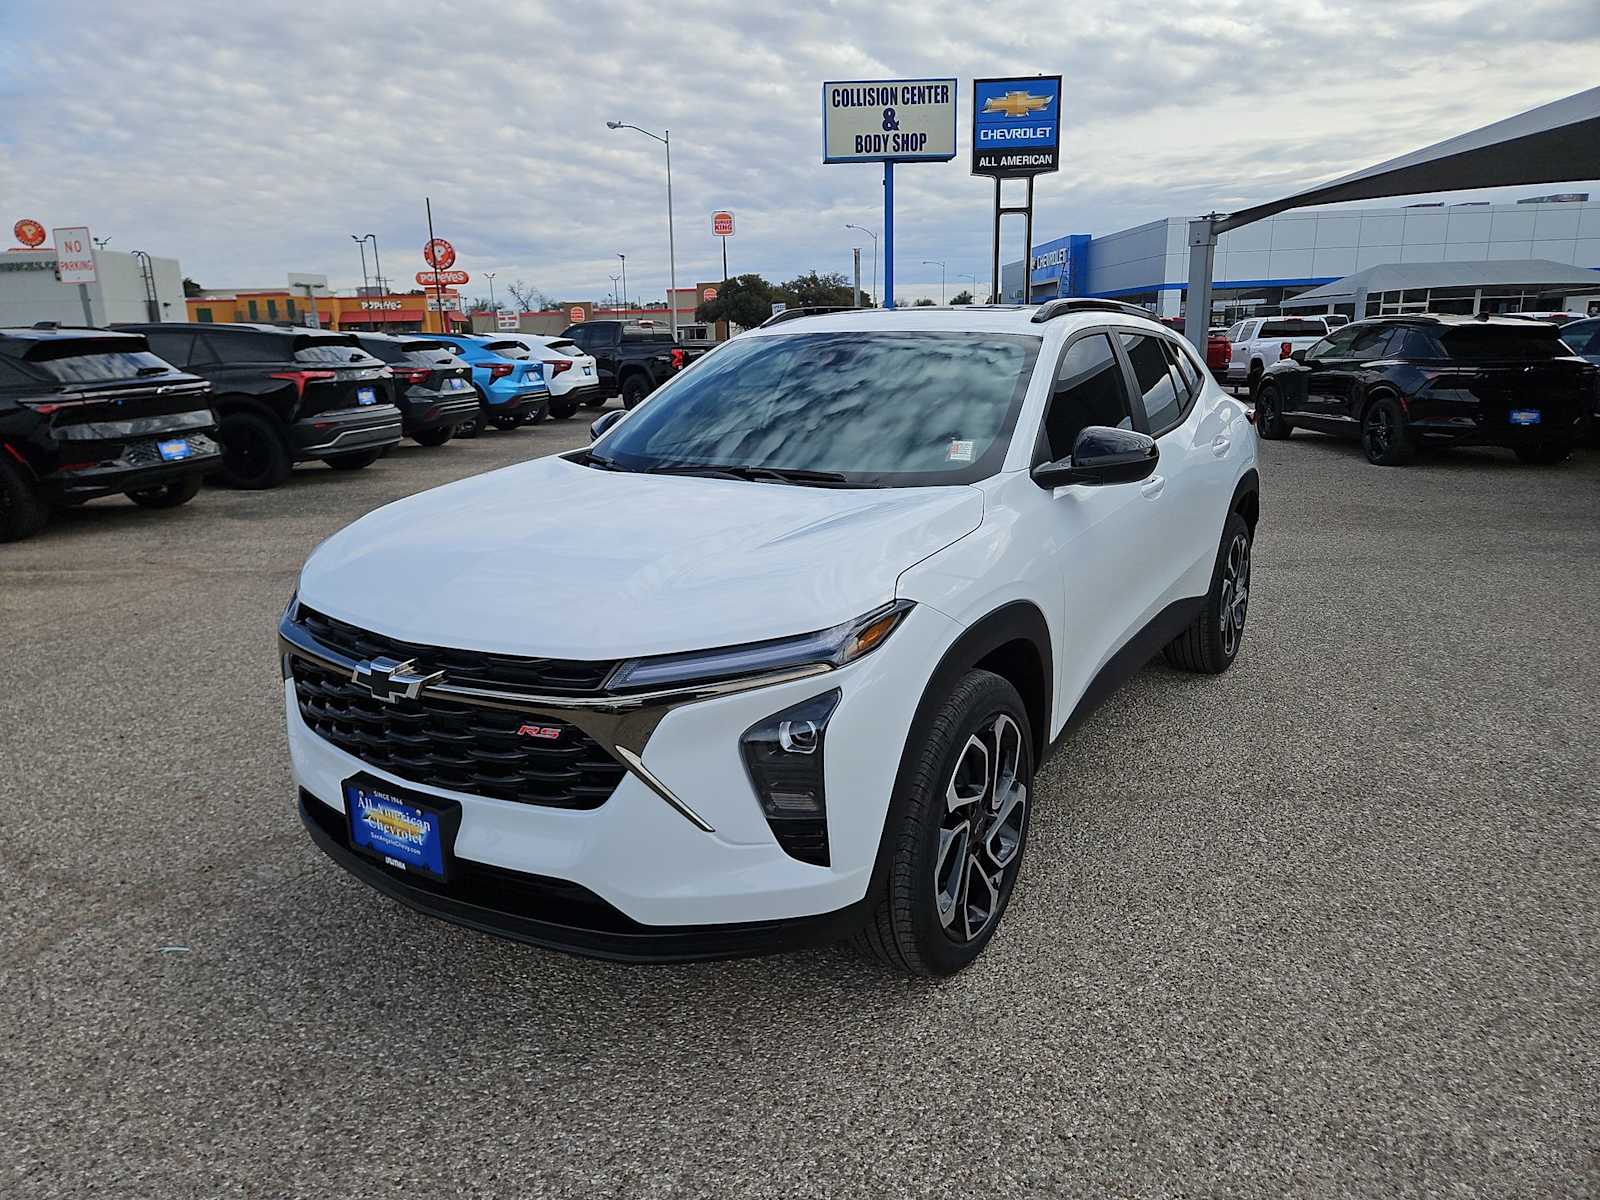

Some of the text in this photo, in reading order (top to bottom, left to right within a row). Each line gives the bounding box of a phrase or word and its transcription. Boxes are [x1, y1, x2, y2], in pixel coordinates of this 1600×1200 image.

[832, 84, 949, 108] COLLISION CENTER
[882, 107, 900, 132] &
[980, 127, 1053, 141] CHEVROLET
[855, 133, 927, 154] BODY SHOP
[979, 154, 1053, 168] ALL AMERICAN
[64, 240, 82, 253] NO
[60, 260, 96, 272] PARKING
[517, 724, 561, 739] RS
[357, 796, 432, 832] All American
[368, 815, 424, 846] Chevrolet
